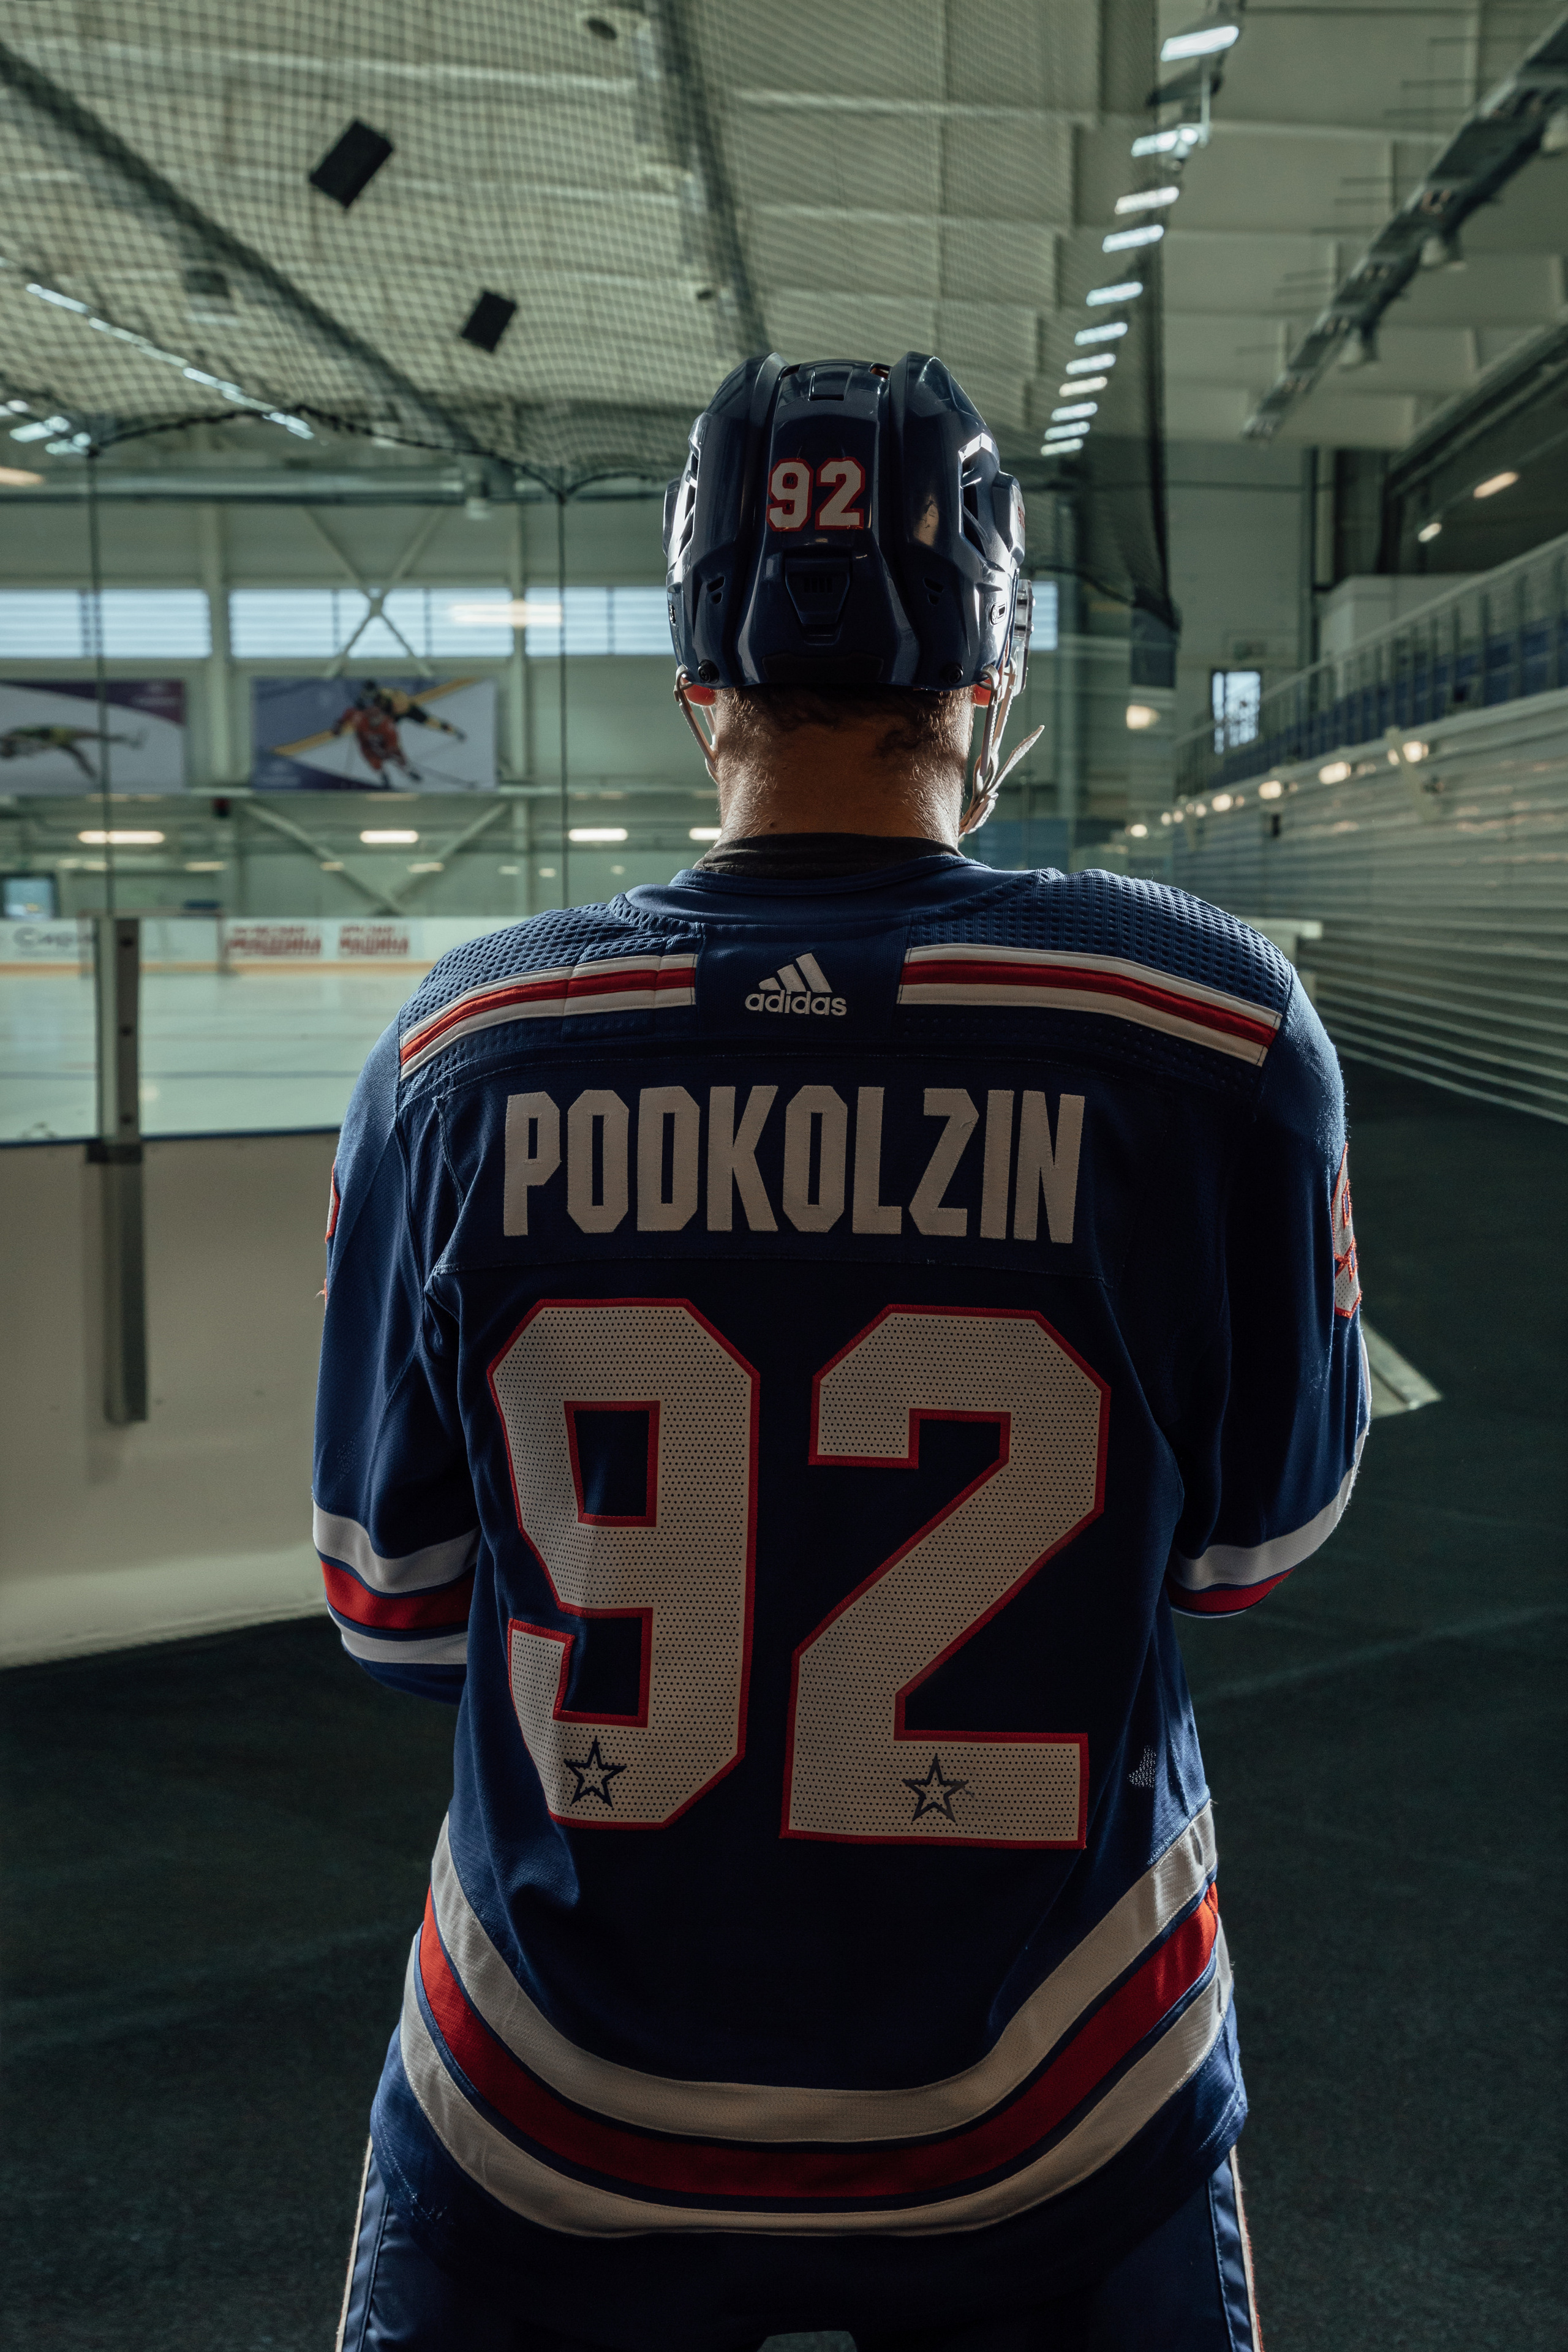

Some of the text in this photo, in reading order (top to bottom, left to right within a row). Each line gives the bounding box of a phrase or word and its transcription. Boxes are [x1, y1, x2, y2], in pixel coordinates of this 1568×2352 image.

[766, 456, 865, 532] 92
[745, 990, 847, 1016] adidas
[503, 1085, 1085, 1244] PODKOLZIN
[488, 1298, 1111, 1849] 92
